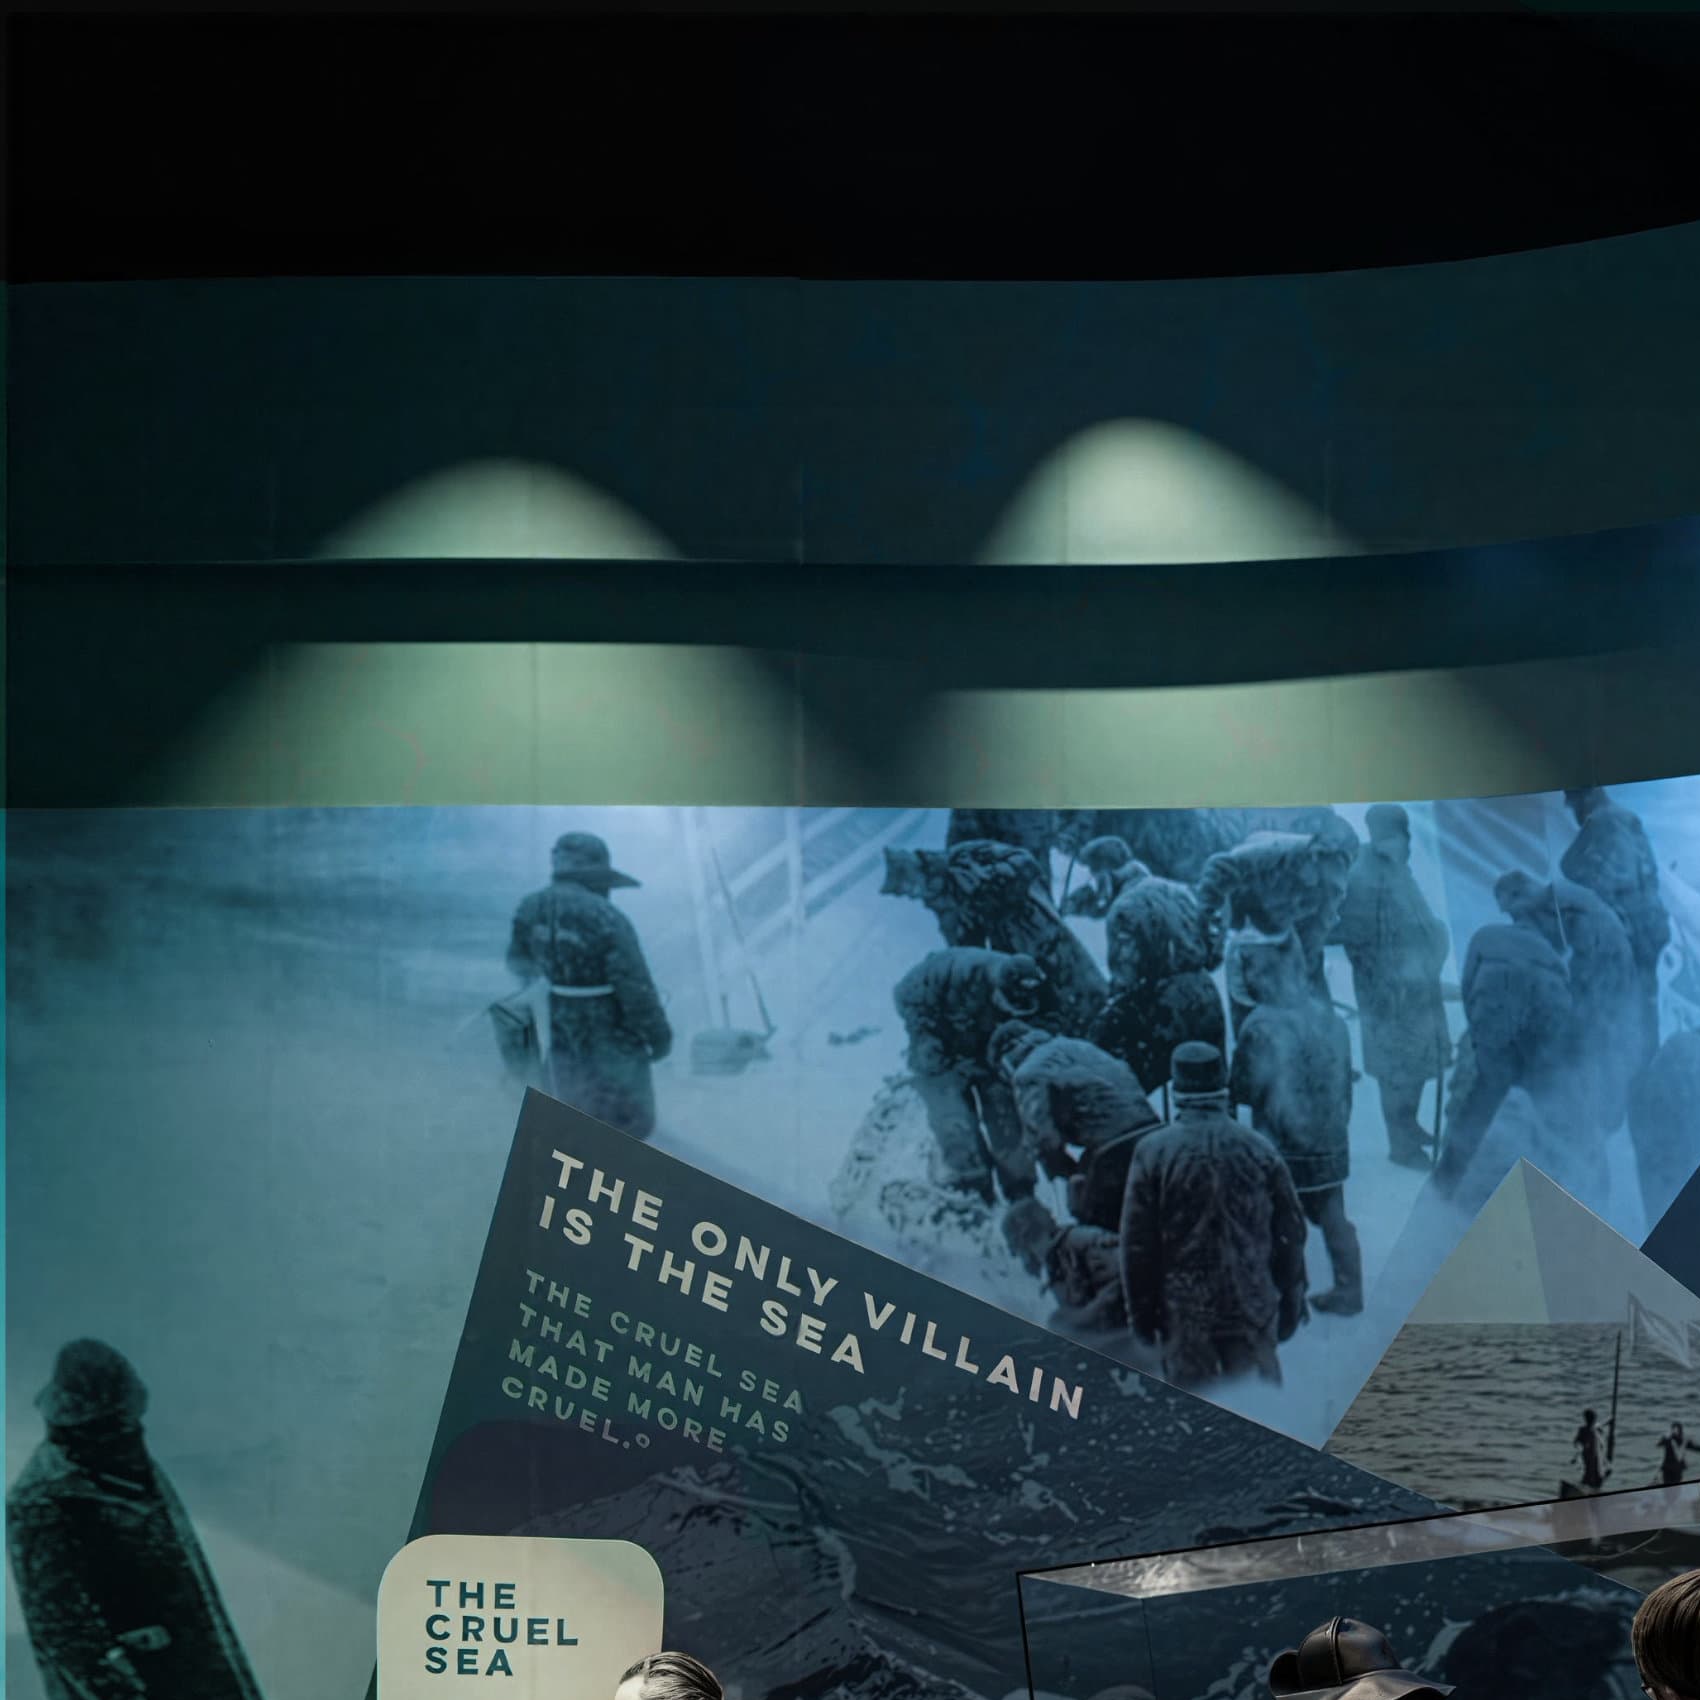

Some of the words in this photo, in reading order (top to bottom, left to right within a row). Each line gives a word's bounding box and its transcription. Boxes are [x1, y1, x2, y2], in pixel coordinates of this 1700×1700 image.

[526, 1268, 593, 1319] THE
[610, 1311, 722, 1379] CRUEL
[739, 1369, 804, 1415] SEA
[539, 1196, 594, 1246] IS
[623, 1233, 734, 1313] THE
[760, 1300, 865, 1374] SEA
[551, 1149, 662, 1231] THE
[692, 1221, 838, 1308] ONLY
[863, 1292, 1084, 1421] VILLAIN
[508, 1338, 612, 1402] MADE
[627, 1392, 727, 1454] MORE
[519, 1302, 614, 1363] THAT
[627, 1355, 704, 1407] MAN
[719, 1396, 790, 1443] HAS
[425, 1614, 578, 1646] CRUEL
[426, 1580, 516, 1609] THE
[424, 1646, 513, 1676] SEA
